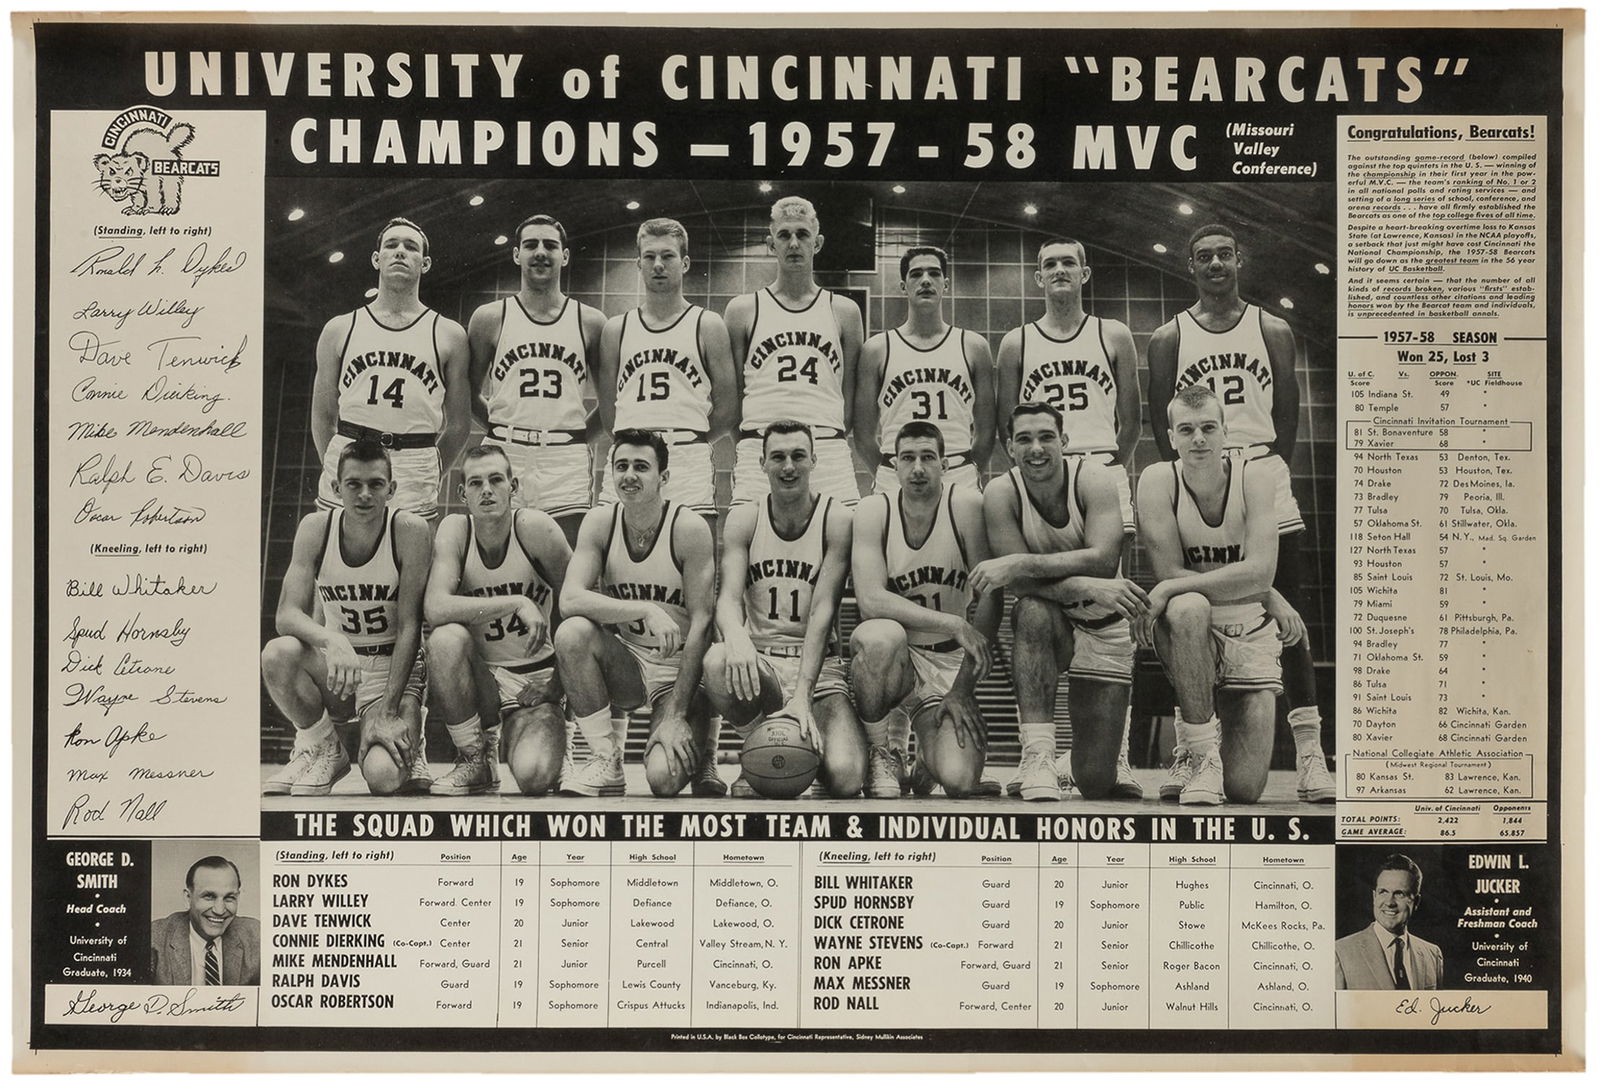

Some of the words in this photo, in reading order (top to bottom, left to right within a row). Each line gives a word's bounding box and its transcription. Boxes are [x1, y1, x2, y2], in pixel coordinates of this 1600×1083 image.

[144, 51, 524, 98] UNIVERSITY
[563, 54, 619, 99] of
[662, 55, 1021, 100] CINCINNATI
[104, 110, 169, 147] CINCINNATI
[1226, 123, 1294, 138] (Missouri
[1348, 125, 1462, 139] Congratulations,
[1470, 125, 1534, 138] Bearcats!
[291, 118, 658, 167] CHAMPIONS
[750, 122, 895, 167] 1957
[964, 123, 1036, 168] 58
[1073, 125, 1196, 170] MVC
[1234, 142, 1280, 157] Valley
[1364, 154, 1411, 162] outstanding
[1414, 154, 1465, 162] game-record
[1469, 153, 1498, 161] (below)
[1502, 153, 1537, 162] compiled
[154, 161, 219, 175] BEARCATS
[1233, 162, 1316, 177] Conference)
[94, 226, 145, 236] (Standing,
[150, 226, 166, 234] left
[170, 227, 180, 235] to
[184, 226, 211, 236] right)
[73, 301, 134, 329] Larry
[137, 299, 205, 328] Willey
[1384, 331, 1434, 342] 1957-58
[1453, 332, 1496, 343] SEASON
[69, 331, 131, 367] Dave
[147, 334, 248, 373] Tenwick
[751, 331, 842, 375] CINCINNATI
[1398, 351, 1422, 362] Won
[1428, 351, 1448, 362] 25,
[1454, 351, 1476, 362] Lost
[1482, 351, 1488, 362] 3
[494, 342, 588, 384] CINCINNATI
[777, 355, 819, 385] 24
[342, 351, 439, 396] CINCINNATI
[617, 348, 702, 393] CINCINNATI
[519, 368, 562, 398] 23
[637, 372, 670, 402] 15
[1023, 359, 1113, 402] CINCINNATI
[366, 375, 406, 409] 14
[883, 368, 973, 408] CINCINNATI
[912, 390, 948, 420] 31
[1044, 383, 1089, 413] 25
[1373, 416, 1413, 426] Cincinnati
[1418, 417, 1455, 425] Invitation
[1460, 417, 1508, 425] Tournament
[68, 422, 117, 440] Mike
[126, 420, 247, 438] Mendenhall
[69, 453, 135, 494] Ralph
[147, 455, 172, 484] E.
[179, 454, 250, 483] Davis
[1354, 466, 1363, 474] 70
[1368, 466, 1402, 474] Houston
[1456, 466, 1492, 475] Houston,
[1496, 466, 1512, 474] Tex.
[66, 579, 103, 597] Bill
[112, 573, 218, 596] Whitaker
[768, 587, 800, 623] 11
[341, 606, 388, 635] 35
[1367, 613, 1407, 623] Duquesne
[1455, 613, 1498, 623] Pittsburgh,
[1502, 613, 1514, 621] Pa.
[63, 616, 108, 648] Spud
[116, 612, 191, 646] Hornsby
[67, 768, 108, 783] Max
[129, 767, 215, 781] Messner
[62, 794, 110, 830] Rod
[120, 793, 167, 823] Nall
[296, 814, 336, 836] THE
[353, 814, 434, 838] SQUAD
[450, 814, 530, 837] WHICH
[547, 815, 605, 837] WON
[622, 815, 664, 837] THE
[680, 814, 746, 837] MOST
[766, 815, 830, 837] TEAM
[847, 817, 862, 838] &
[880, 817, 1020, 840] INDIVIDUAL
[1037, 817, 1135, 840] HONORS
[1152, 818, 1176, 840] IN
[1193, 818, 1234, 840] THE
[1252, 818, 1274, 840] U.
[1289, 818, 1309, 840] S.
[66, 852, 114, 866] GEORGE
[122, 852, 134, 866] D.
[1469, 855, 1510, 868] EDWIN
[1519, 855, 1529, 868] L.
[77, 874, 117, 888] SMITH
[274, 874, 299, 887] RON
[308, 874, 347, 887] DYKES
[551, 878, 600, 888] Sophomore
[627, 878, 678, 886] Middletown
[710, 878, 763, 888] Middletown,
[767, 879, 778, 887] O.
[815, 876, 840, 888] BILL
[846, 876, 912, 889] WHITAKER
[1475, 879, 1520, 893] JUCKER
[274, 894, 314, 907] LARRY
[322, 894, 368, 907] WILLEY
[814, 896, 846, 909] SPUD
[854, 896, 914, 909] HORNSBY
[66, 904, 93, 913] Head
[96, 904, 126, 913] Coach
[1464, 907, 1509, 916] Assistant
[1513, 907, 1532, 916] and
[273, 914, 307, 927] DAVE
[314, 914, 371, 927] TENWICK
[1458, 919, 1505, 928] Freshman
[1509, 919, 1537, 928] Coach
[70, 936, 113, 947] University
[118, 936, 127, 944] of
[273, 934, 319, 947] CONNIE
[327, 934, 384, 947] DIERKING
[1472, 942, 1514, 952] University
[1519, 942, 1528, 950] of
[74, 952, 116, 961] Cincinnati
[273, 954, 304, 967] MIKE
[312, 954, 397, 968] MENDENHALL
[63, 967, 108, 978] Graduate,
[114, 968, 131, 977] 1934
[1464, 973, 1508, 983] Graduate,
[1514, 974, 1532, 982] 1940
[273, 974, 314, 987] RALPH
[322, 974, 360, 988] DAVIS
[63, 987, 141, 1023] George
[169, 986, 246, 1017] Smith
[272, 994, 312, 1008] OSCAR
[320, 994, 393, 1008] ROBERTSON
[1430, 996, 1492, 1026] Jucker
